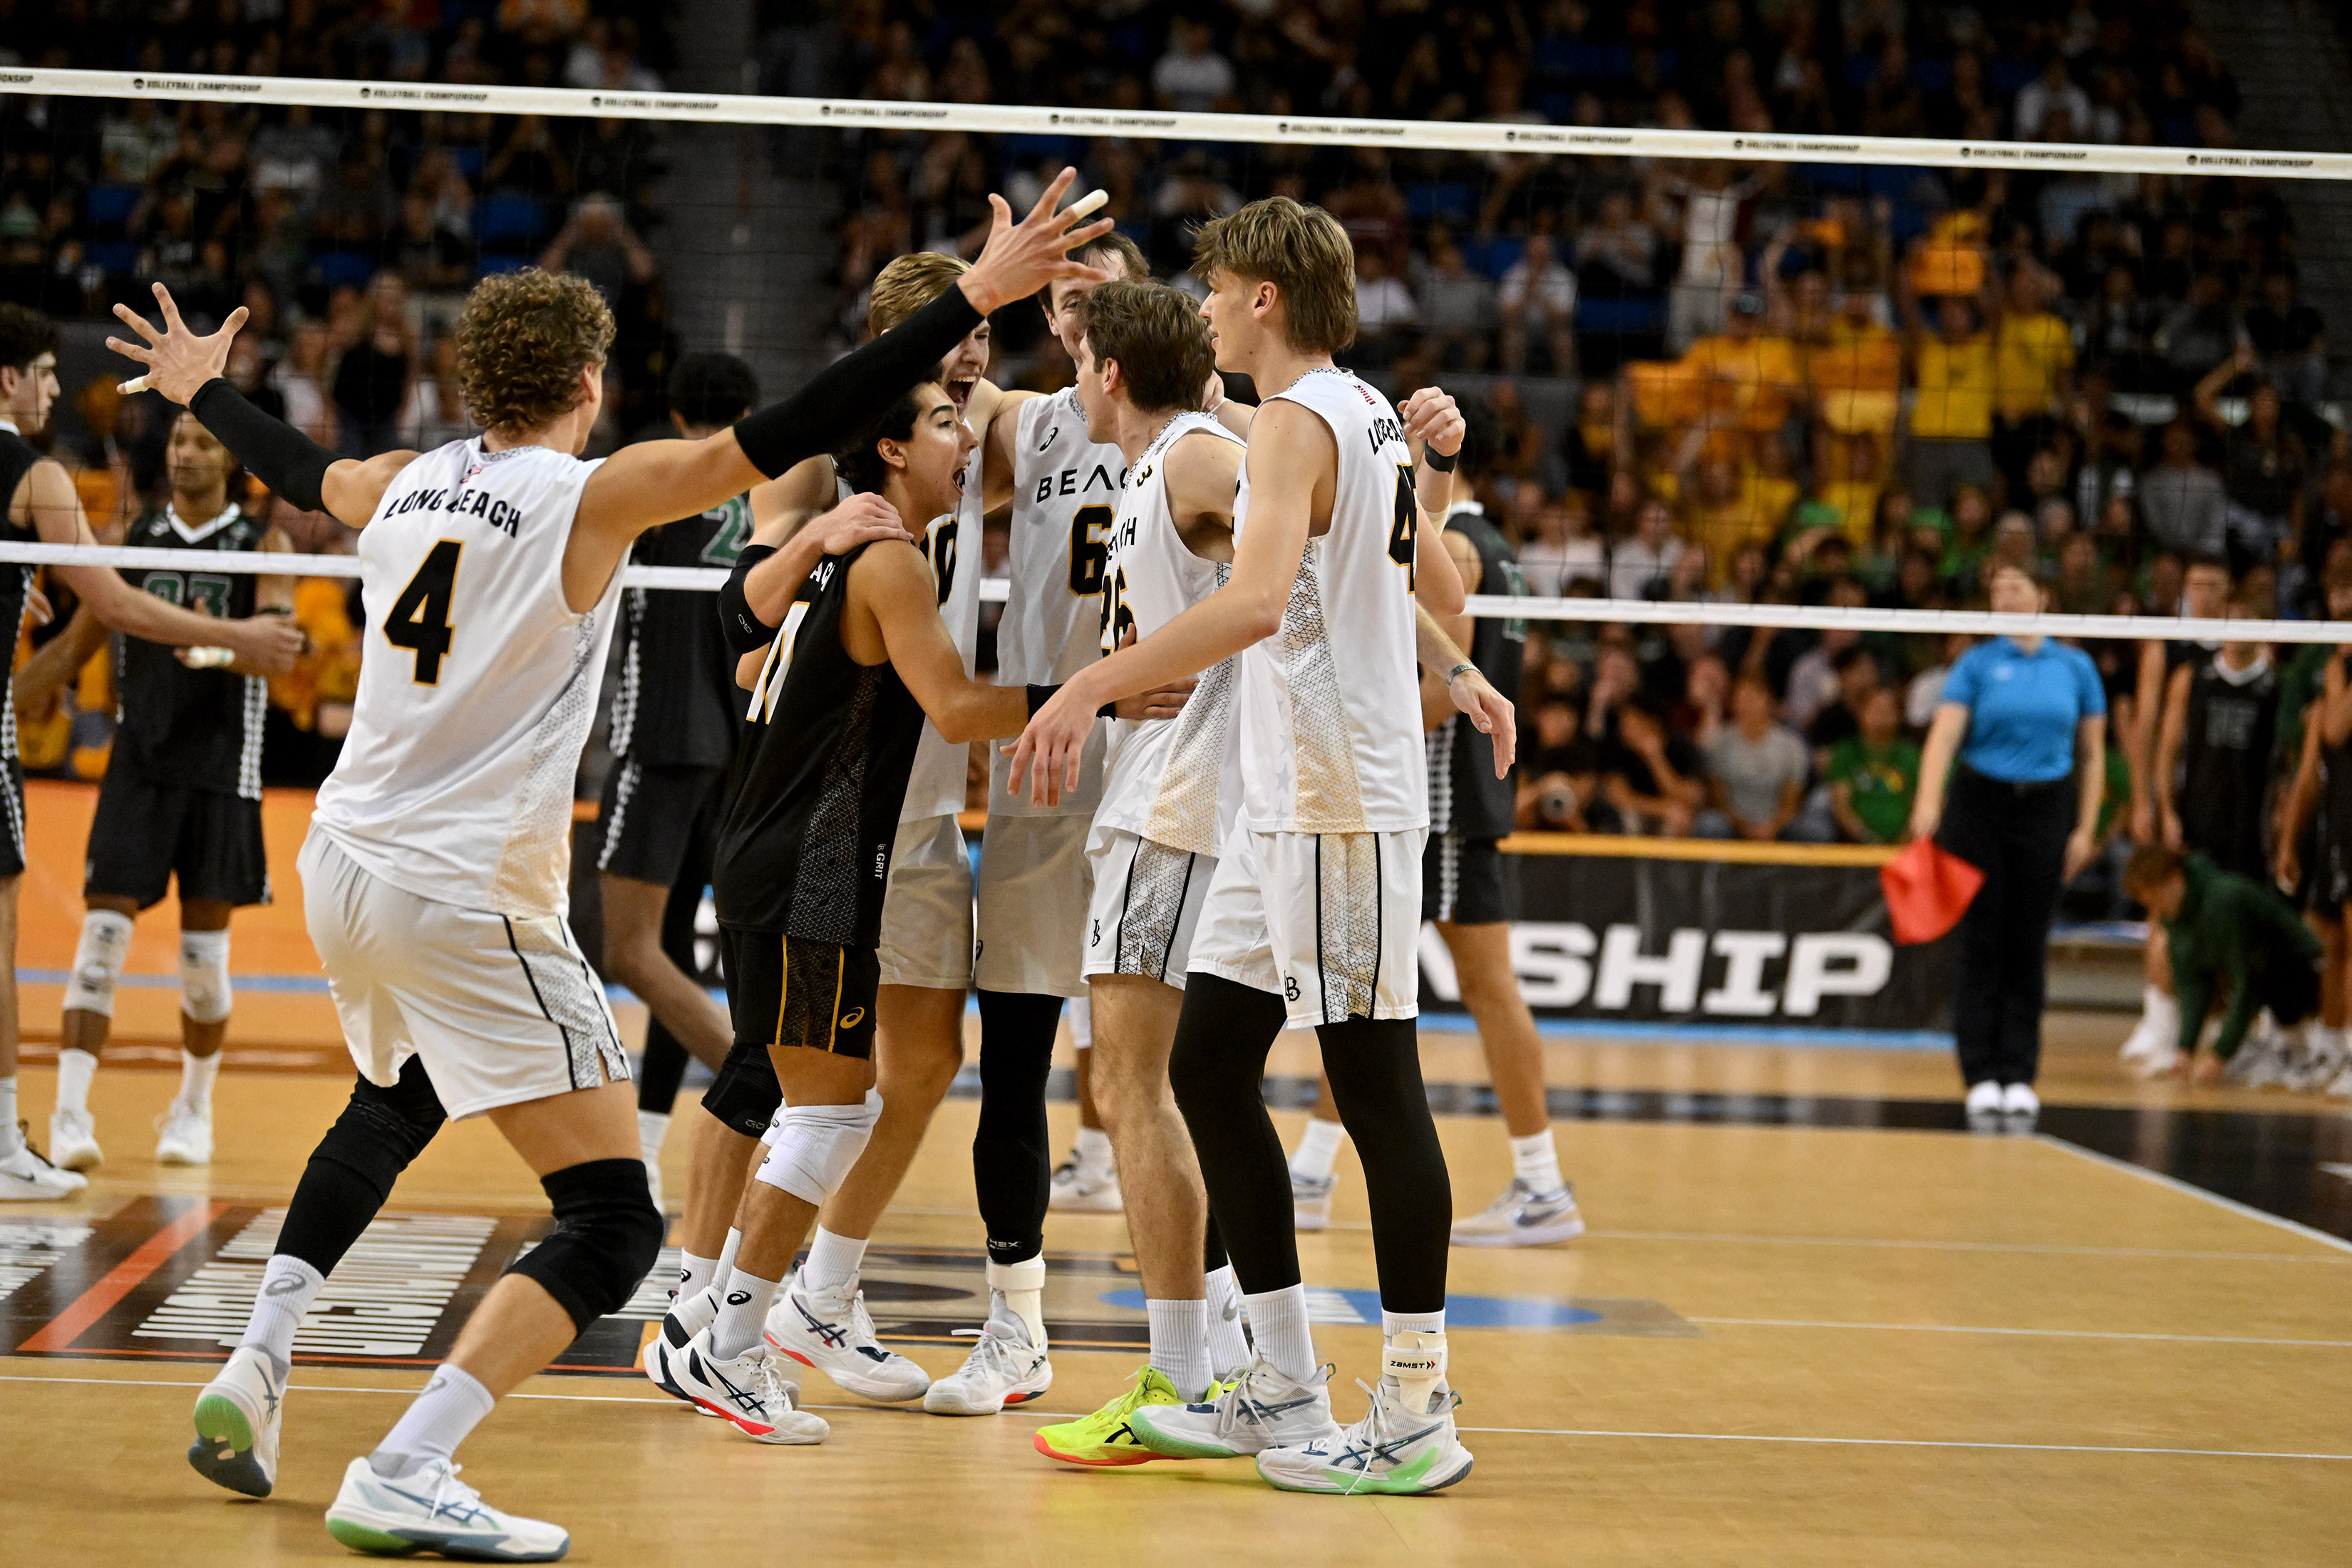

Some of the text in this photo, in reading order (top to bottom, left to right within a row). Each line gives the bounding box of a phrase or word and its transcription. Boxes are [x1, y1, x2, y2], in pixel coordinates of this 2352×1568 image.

[1036, 464, 1128, 503] BEA
[382, 488, 448, 520] LONG
[1067, 503, 1115, 598] 6
[383, 538, 465, 686] 4
[875, 852, 885, 880] GRIT
[989, 1238, 1018, 1248] HEX
